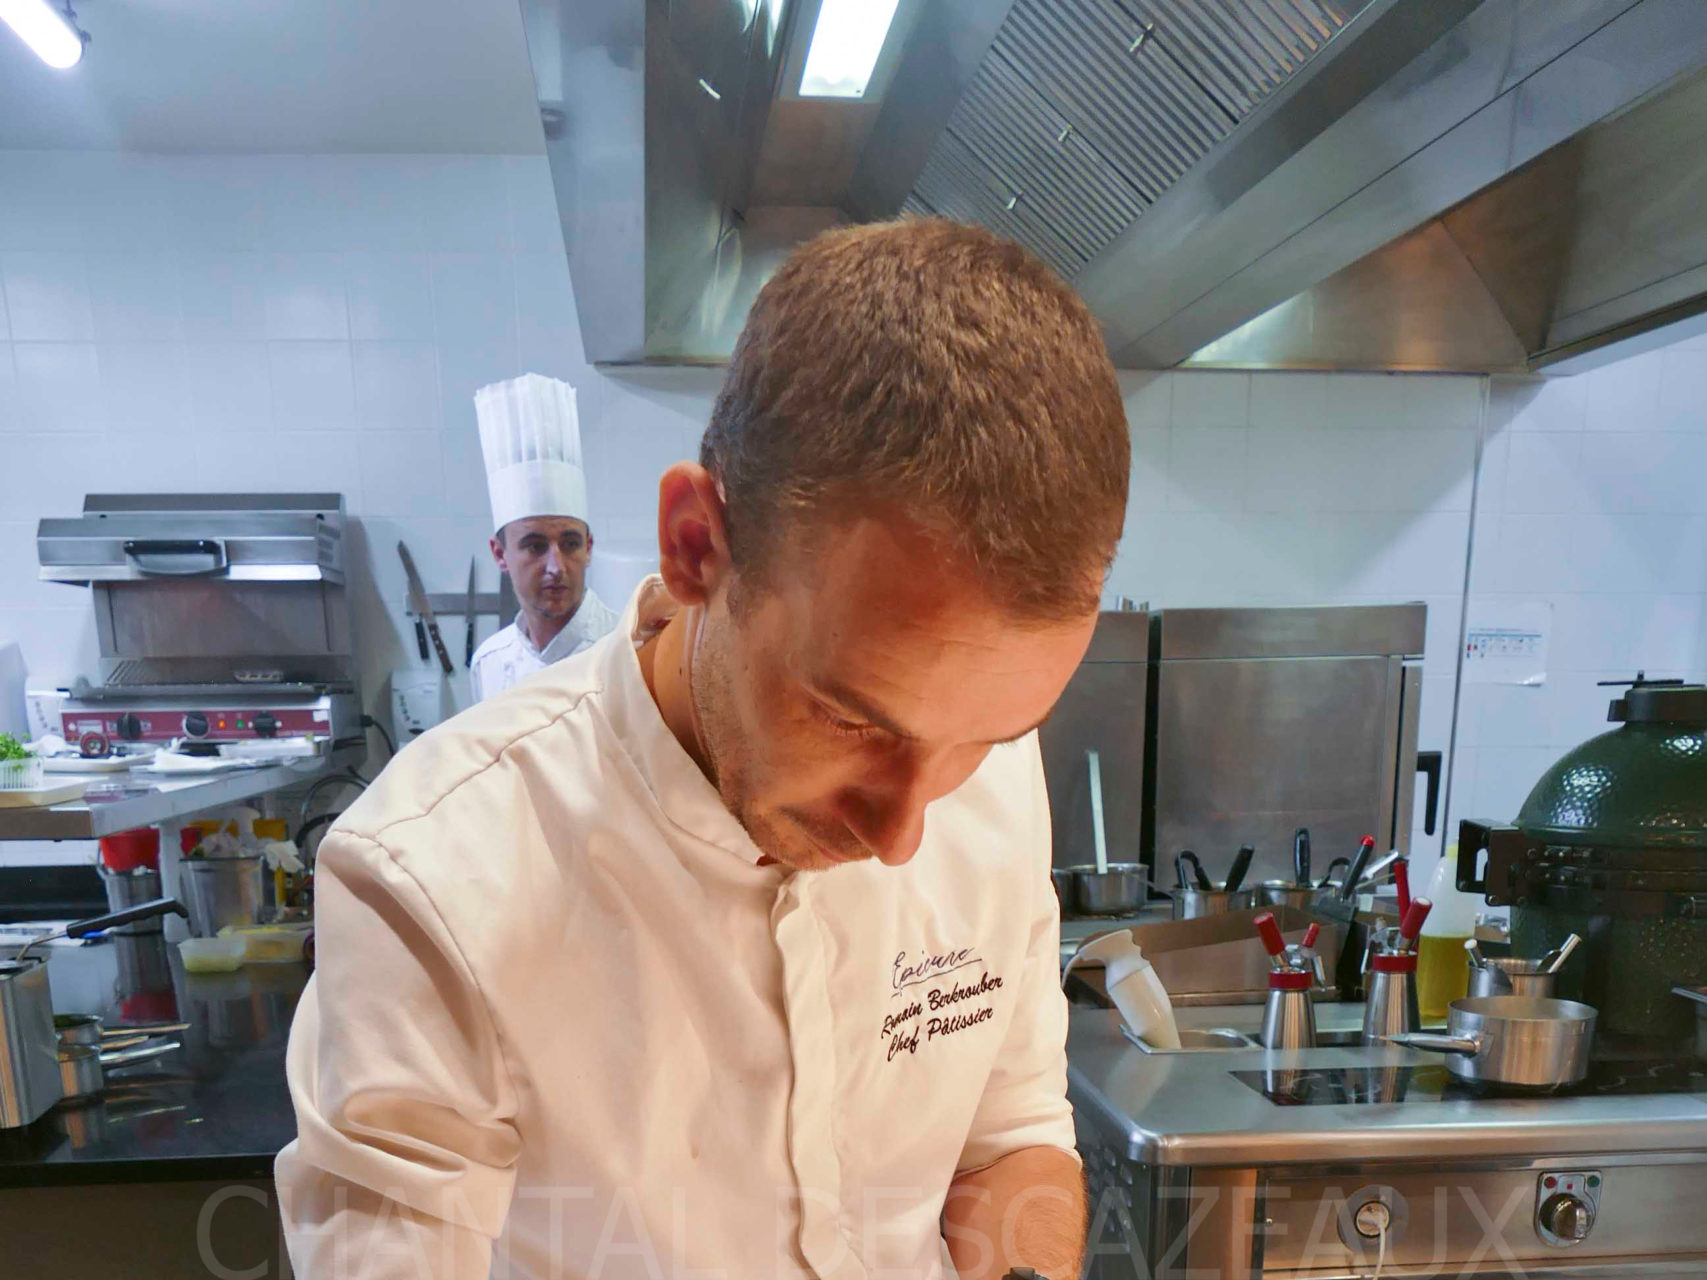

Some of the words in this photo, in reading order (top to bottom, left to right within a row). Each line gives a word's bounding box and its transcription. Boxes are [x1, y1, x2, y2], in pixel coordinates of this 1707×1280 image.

[893, 947, 975, 997] Epicure
[887, 1026, 919, 1062] Chef
[927, 1007, 993, 1042] Pâtissier
